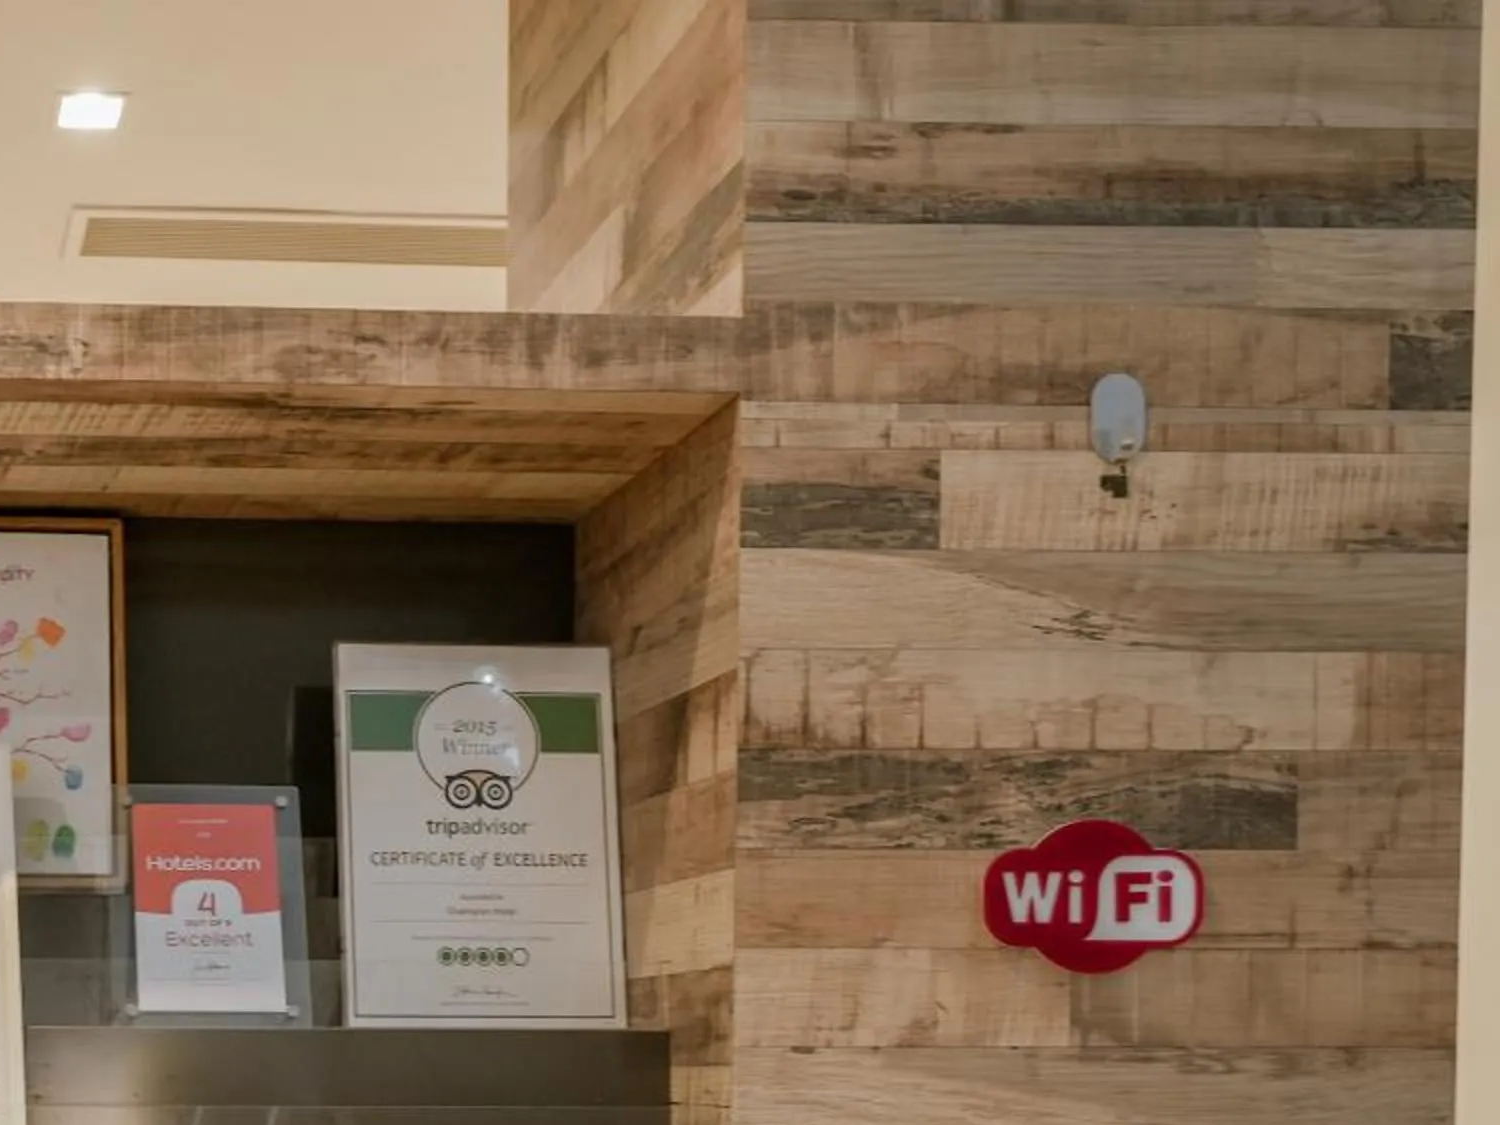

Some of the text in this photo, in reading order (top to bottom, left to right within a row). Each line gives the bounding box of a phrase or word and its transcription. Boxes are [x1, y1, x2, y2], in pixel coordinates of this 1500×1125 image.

[451, 718, 498, 737] 2015
[426, 817, 529, 839] tripadvisor
[145, 855, 262, 872] Hotels.com
[369, 850, 590, 870] CERTIFICATE of EXCELLENCE
[197, 891, 216, 916] 4
[164, 930, 256, 948] Excellent
